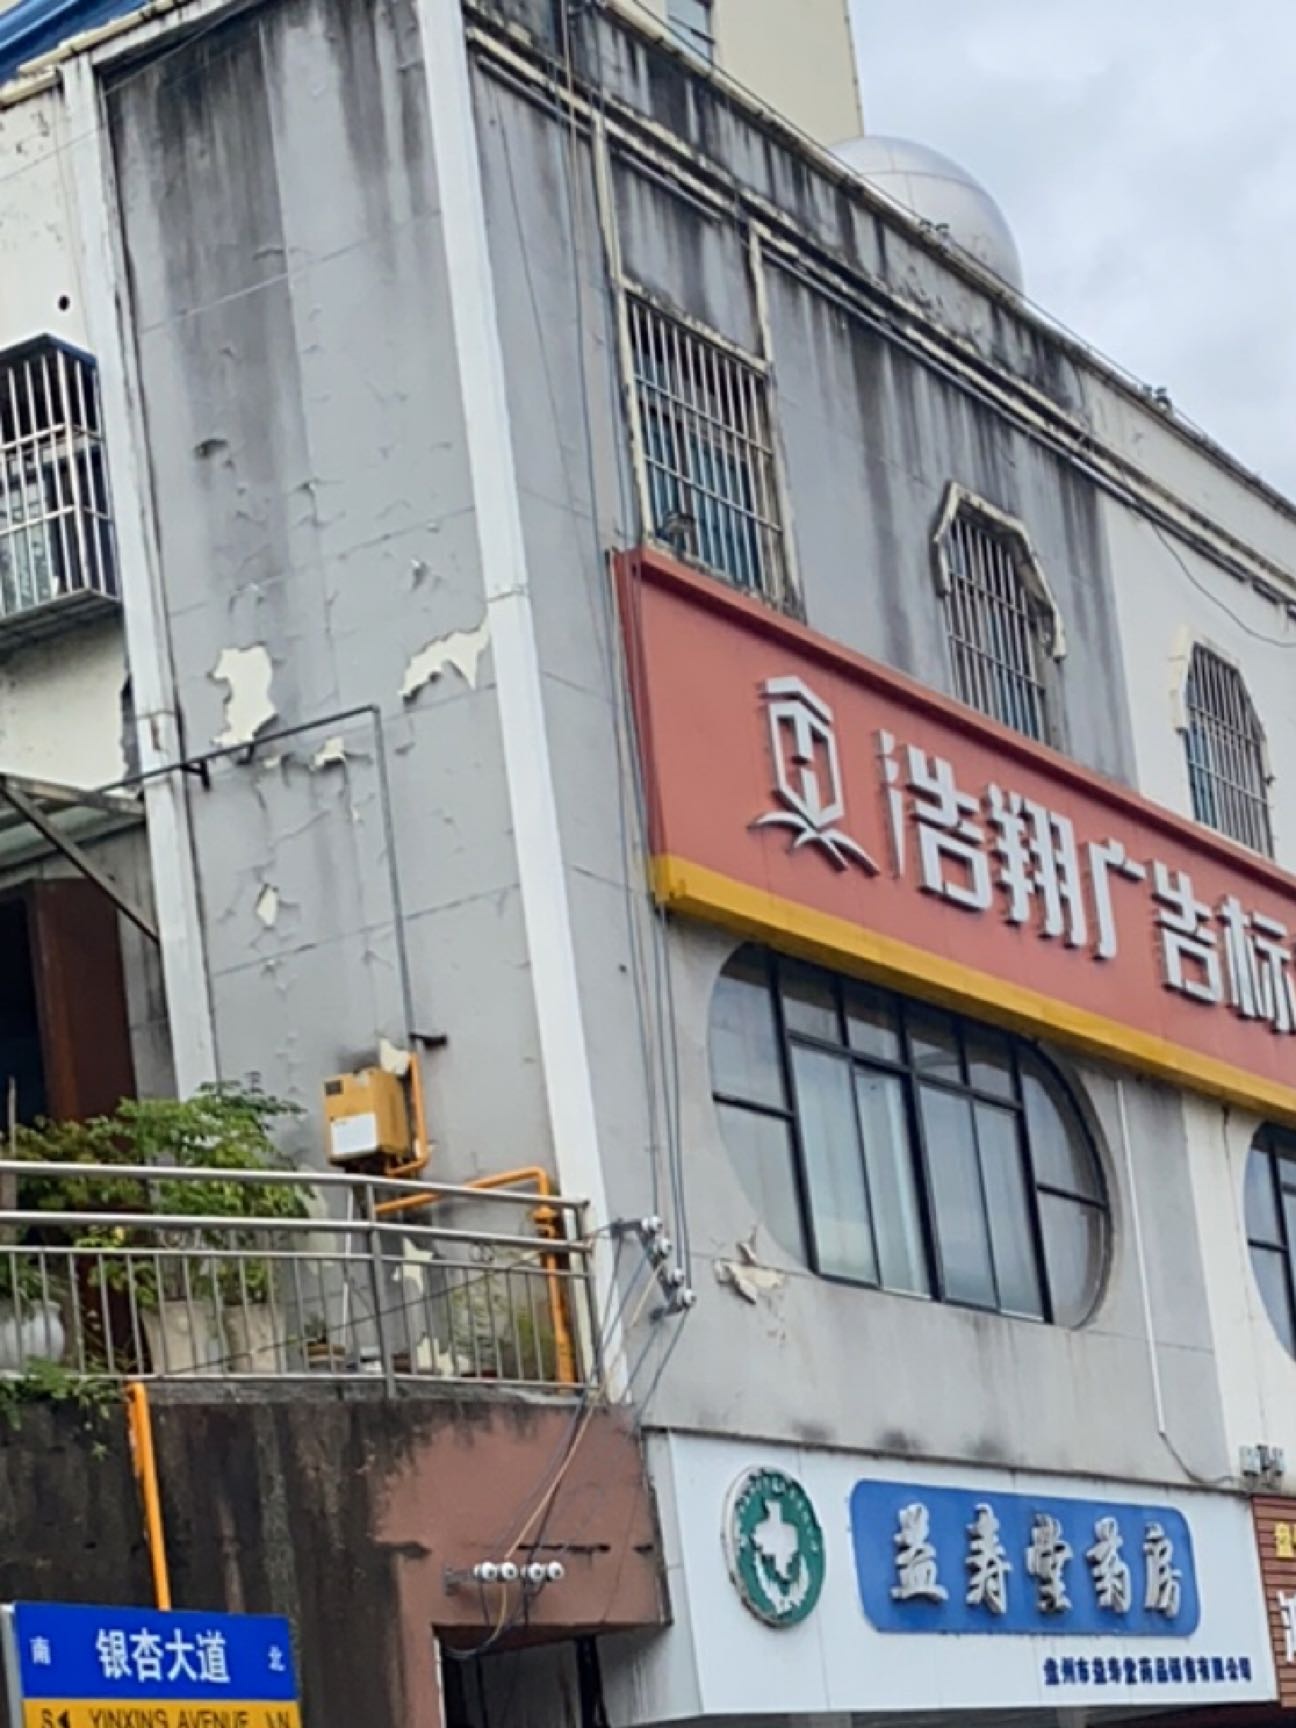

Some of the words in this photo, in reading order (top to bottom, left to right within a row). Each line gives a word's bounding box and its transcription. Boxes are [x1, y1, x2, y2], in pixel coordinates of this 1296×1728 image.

[891, 1502, 1182, 1618] 益寿堂药房
[95, 1627, 230, 1684] 银杏大道
